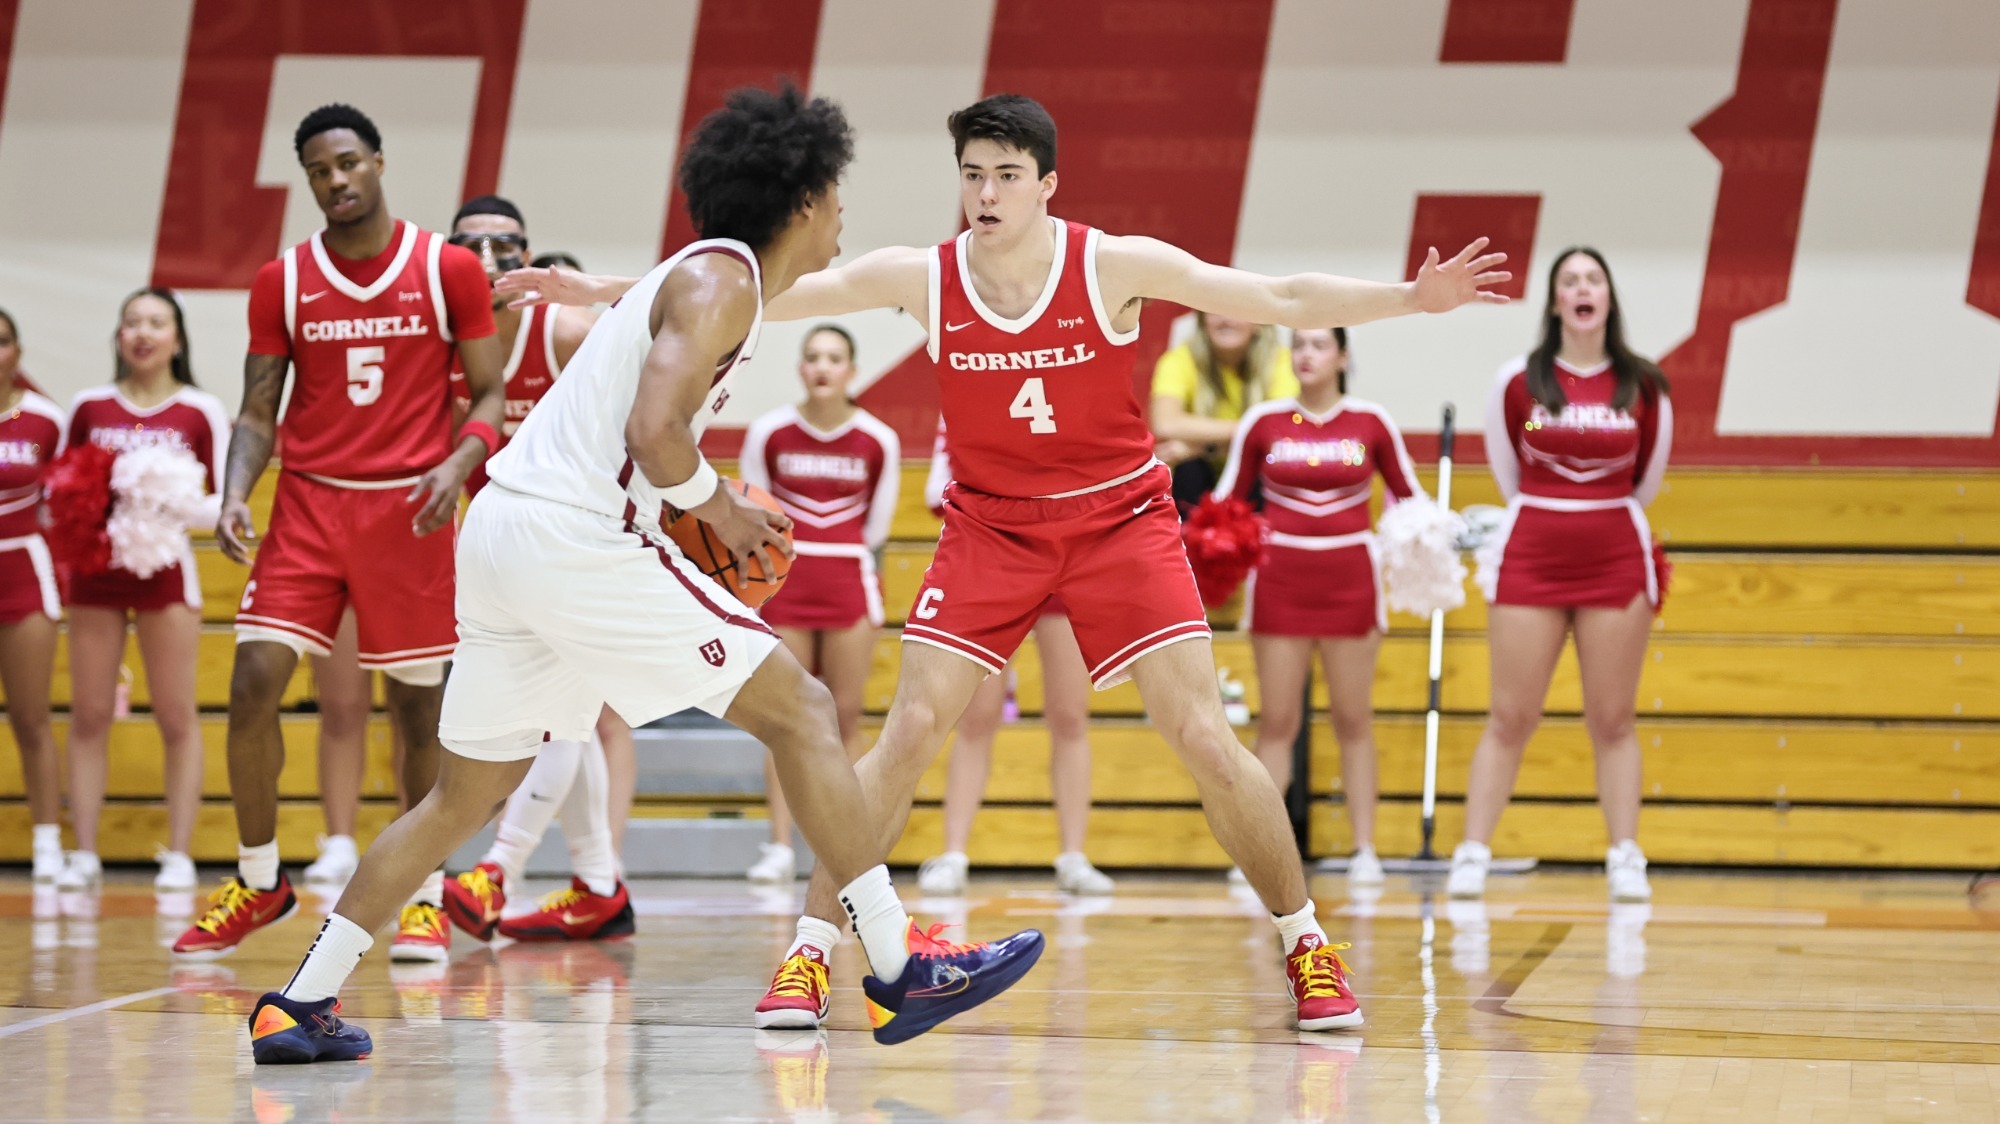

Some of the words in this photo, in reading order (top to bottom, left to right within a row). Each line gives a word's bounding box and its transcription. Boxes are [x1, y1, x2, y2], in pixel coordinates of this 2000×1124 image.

[302, 315, 429, 342] CORNELL
[949, 343, 1096, 371] CORNELL
[346, 345, 386, 407] 5
[1009, 377, 1057, 434] 4
[777, 453, 869, 480] CORNELL
[916, 587, 944, 620] C
[703, 642, 725, 664] H
